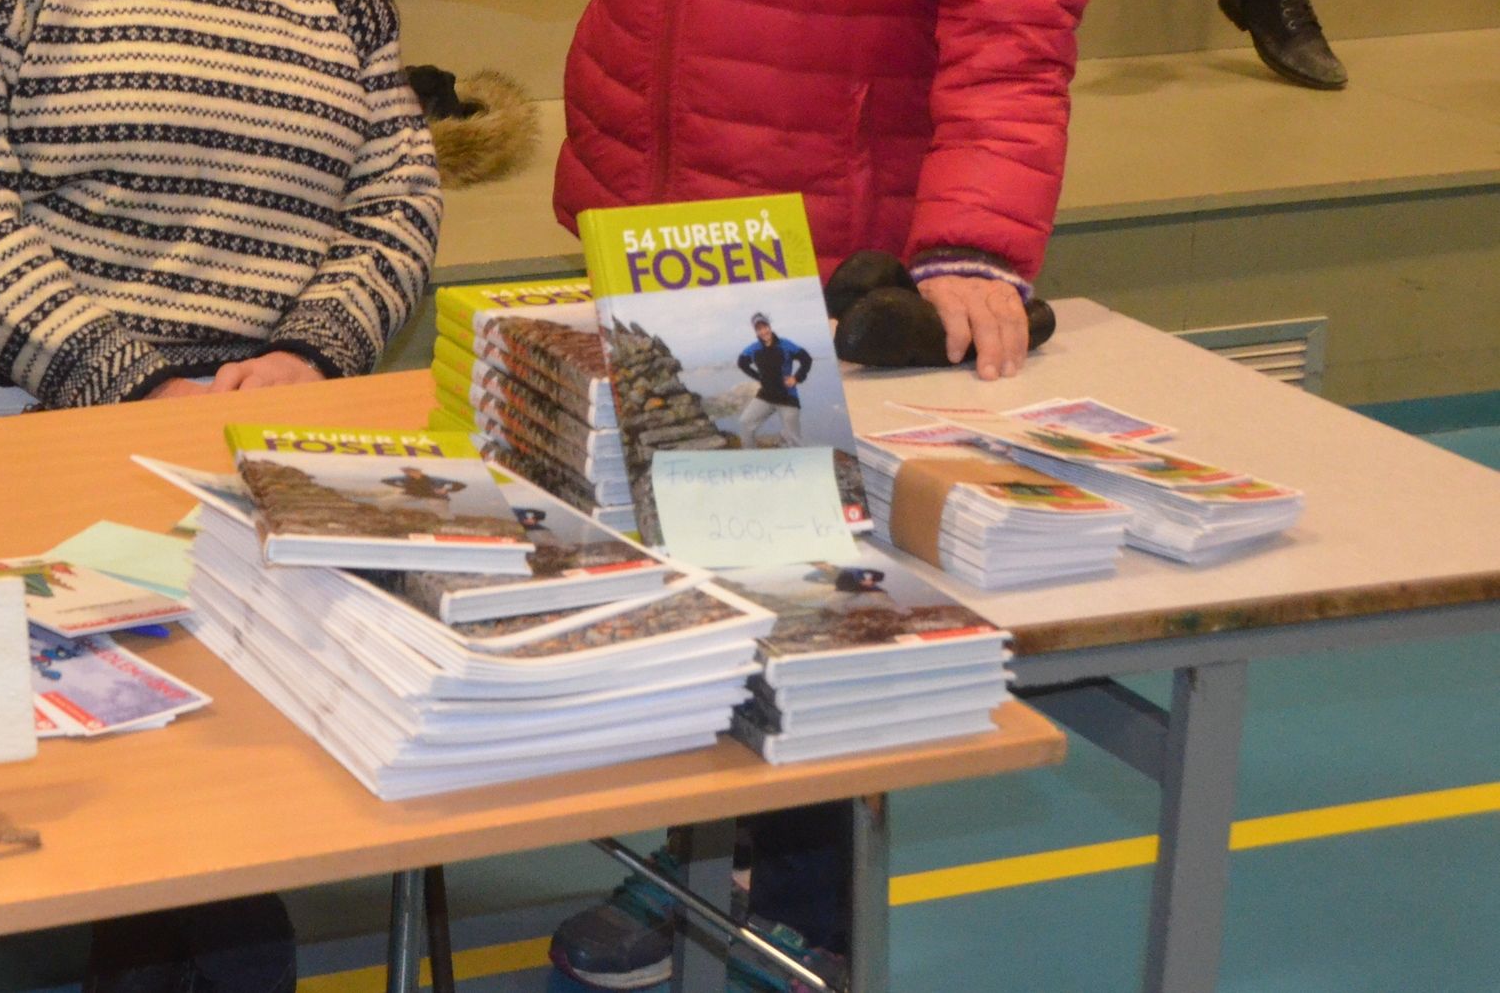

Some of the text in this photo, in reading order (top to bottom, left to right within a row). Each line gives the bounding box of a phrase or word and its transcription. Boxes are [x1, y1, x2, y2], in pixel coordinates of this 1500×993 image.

[622, 209, 780, 254] 54 TURER PÅ
[625, 238, 788, 293] FOSEN
[263, 437, 445, 458] FOSEN
